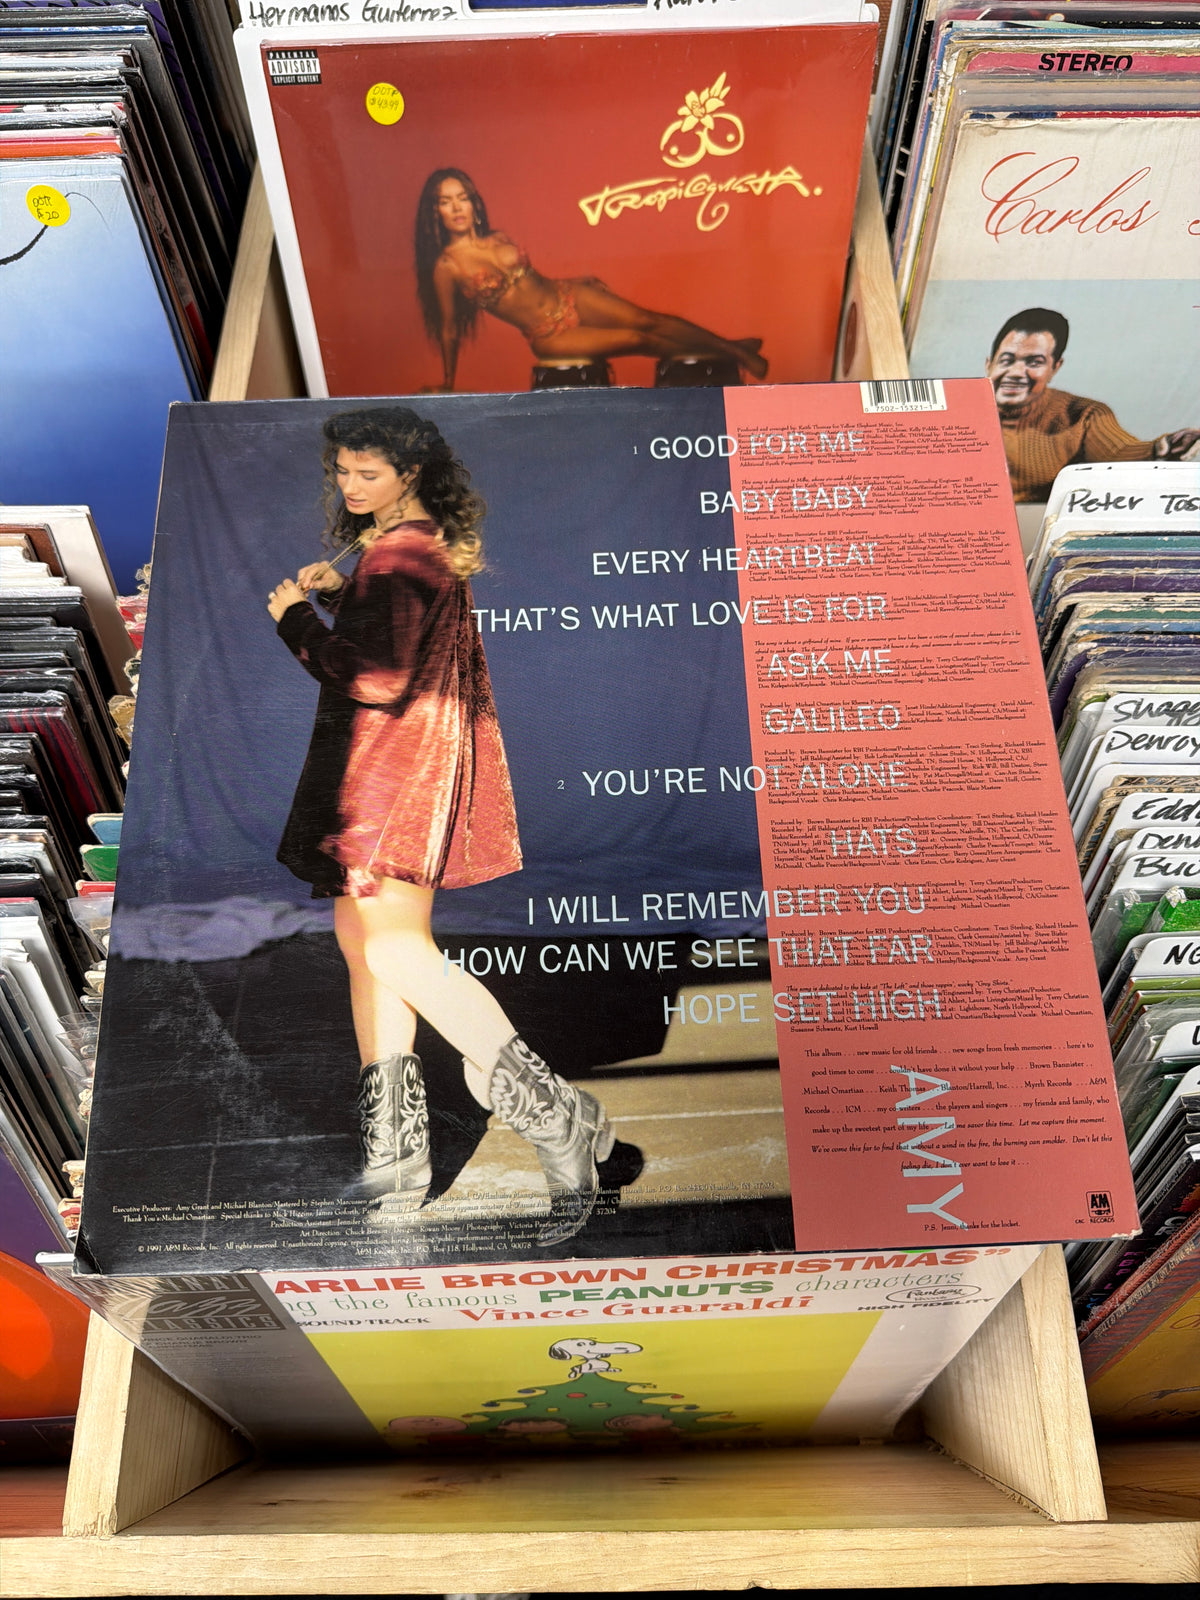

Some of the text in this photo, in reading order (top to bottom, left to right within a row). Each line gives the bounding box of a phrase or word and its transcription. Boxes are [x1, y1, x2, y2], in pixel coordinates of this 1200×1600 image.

[249, 1, 350, 28] Hermanos
[269, 50, 316, 59] PARENTAL
[271, 59, 319, 75] ADVISORY
[1038, 52, 1133, 72] STEREO
[273, 75, 319, 84] EXPLICIT CONTENT
[981, 151, 1160, 244] Carlos
[649, 435, 738, 460] GOOD
[750, 433, 805, 457] FOR
[819, 430, 868, 454] ME
[700, 489, 777, 514] BABY
[791, 484, 873, 512] BABY
[1068, 488, 1144, 513] Peter
[592, 549, 690, 576] EVERY
[701, 541, 879, 572] HEARTBEAT
[591, 603, 680, 630] WHAT
[691, 601, 772, 627] LOVE
[784, 598, 813, 624] IS
[824, 595, 888, 622] FOR
[767, 649, 894, 679] ASK ME
[765, 705, 902, 735] GALILEO
[719, 764, 784, 794] NOT
[799, 761, 910, 790] ALONE
[829, 827, 918, 856] HATS
[1132, 856, 1200, 878] Buc
[528, 886, 926, 926] I WILL REMEMBER YOU
[443, 934, 935, 978] HOW CAN WE SEE THAT FAR
[662, 988, 942, 1026] HOPE SET HIGH
[804, 1048, 820, 1057] This
[821, 1048, 842, 1057] album
[892, 1046, 902, 1055] for
[904, 1046, 914, 1055] old
[915, 1046, 938, 1054] friends
[986, 1044, 1002, 1052] from
[1004, 1043, 1020, 1052] fresh
[811, 1068, 827, 1076] good
[828, 1068, 847, 1076] times
[917, 1064, 932, 1073] have
[934, 1064, 950, 1072] done
[951, 1064, 957, 1072] it
[958, 1062, 983, 1072] without
[984, 1064, 999, 1072] your
[1000, 1061, 1015, 1072] help
[1030, 1061, 1050, 1070] Brown
[1052, 1060, 1084, 1068] Bannister
[831, 1086, 864, 1094] Omartian
[879, 1084, 898, 1093] Keith
[899, 1084, 926, 1092] Thomas
[1024, 1079, 1045, 1090] Myrrh
[1046, 1078, 1072, 1087] Records
[1089, 1077, 1108, 1086] A&M
[804, 1106, 830, 1114] Records
[846, 1105, 861, 1113] ICM
[948, 1102, 970, 1111] players
[972, 1100, 984, 1109] and
[986, 1100, 1008, 1110] singers
[1034, 1098, 1057, 1107] friends
[1058, 1097, 1070, 1106] and
[1096, 1096, 1110, 1104] who
[890, 1064, 968, 1232] AMY
[112, 1206, 140, 1214] Executive
[176, 1204, 190, 1212] Amy
[192, 1202, 210, 1210] Grant
[210, 1202, 222, 1210] and
[224, 1200, 246, 1210] Michael
[960, 1221, 980, 1230] thanks
[980, 1220, 990, 1228] for
[990, 1220, 1000, 1228] the
[146, 1244, 162, 1252] 1991
[164, 1244, 181, 1252] A&M
[441, 1267, 647, 1289] BROWN
[329, 1294, 389, 1311] the
[405, 1291, 518, 1308] famous
[538, 1280, 774, 1303] PEANUTS
[796, 1272, 964, 1293] characters
[912, 1297, 996, 1308] FIDELITY
[364, 1317, 431, 1326] TRACK
[458, 1296, 815, 1322] Vince Guaraldi
[138, 1315, 277, 1330] LASSICS
